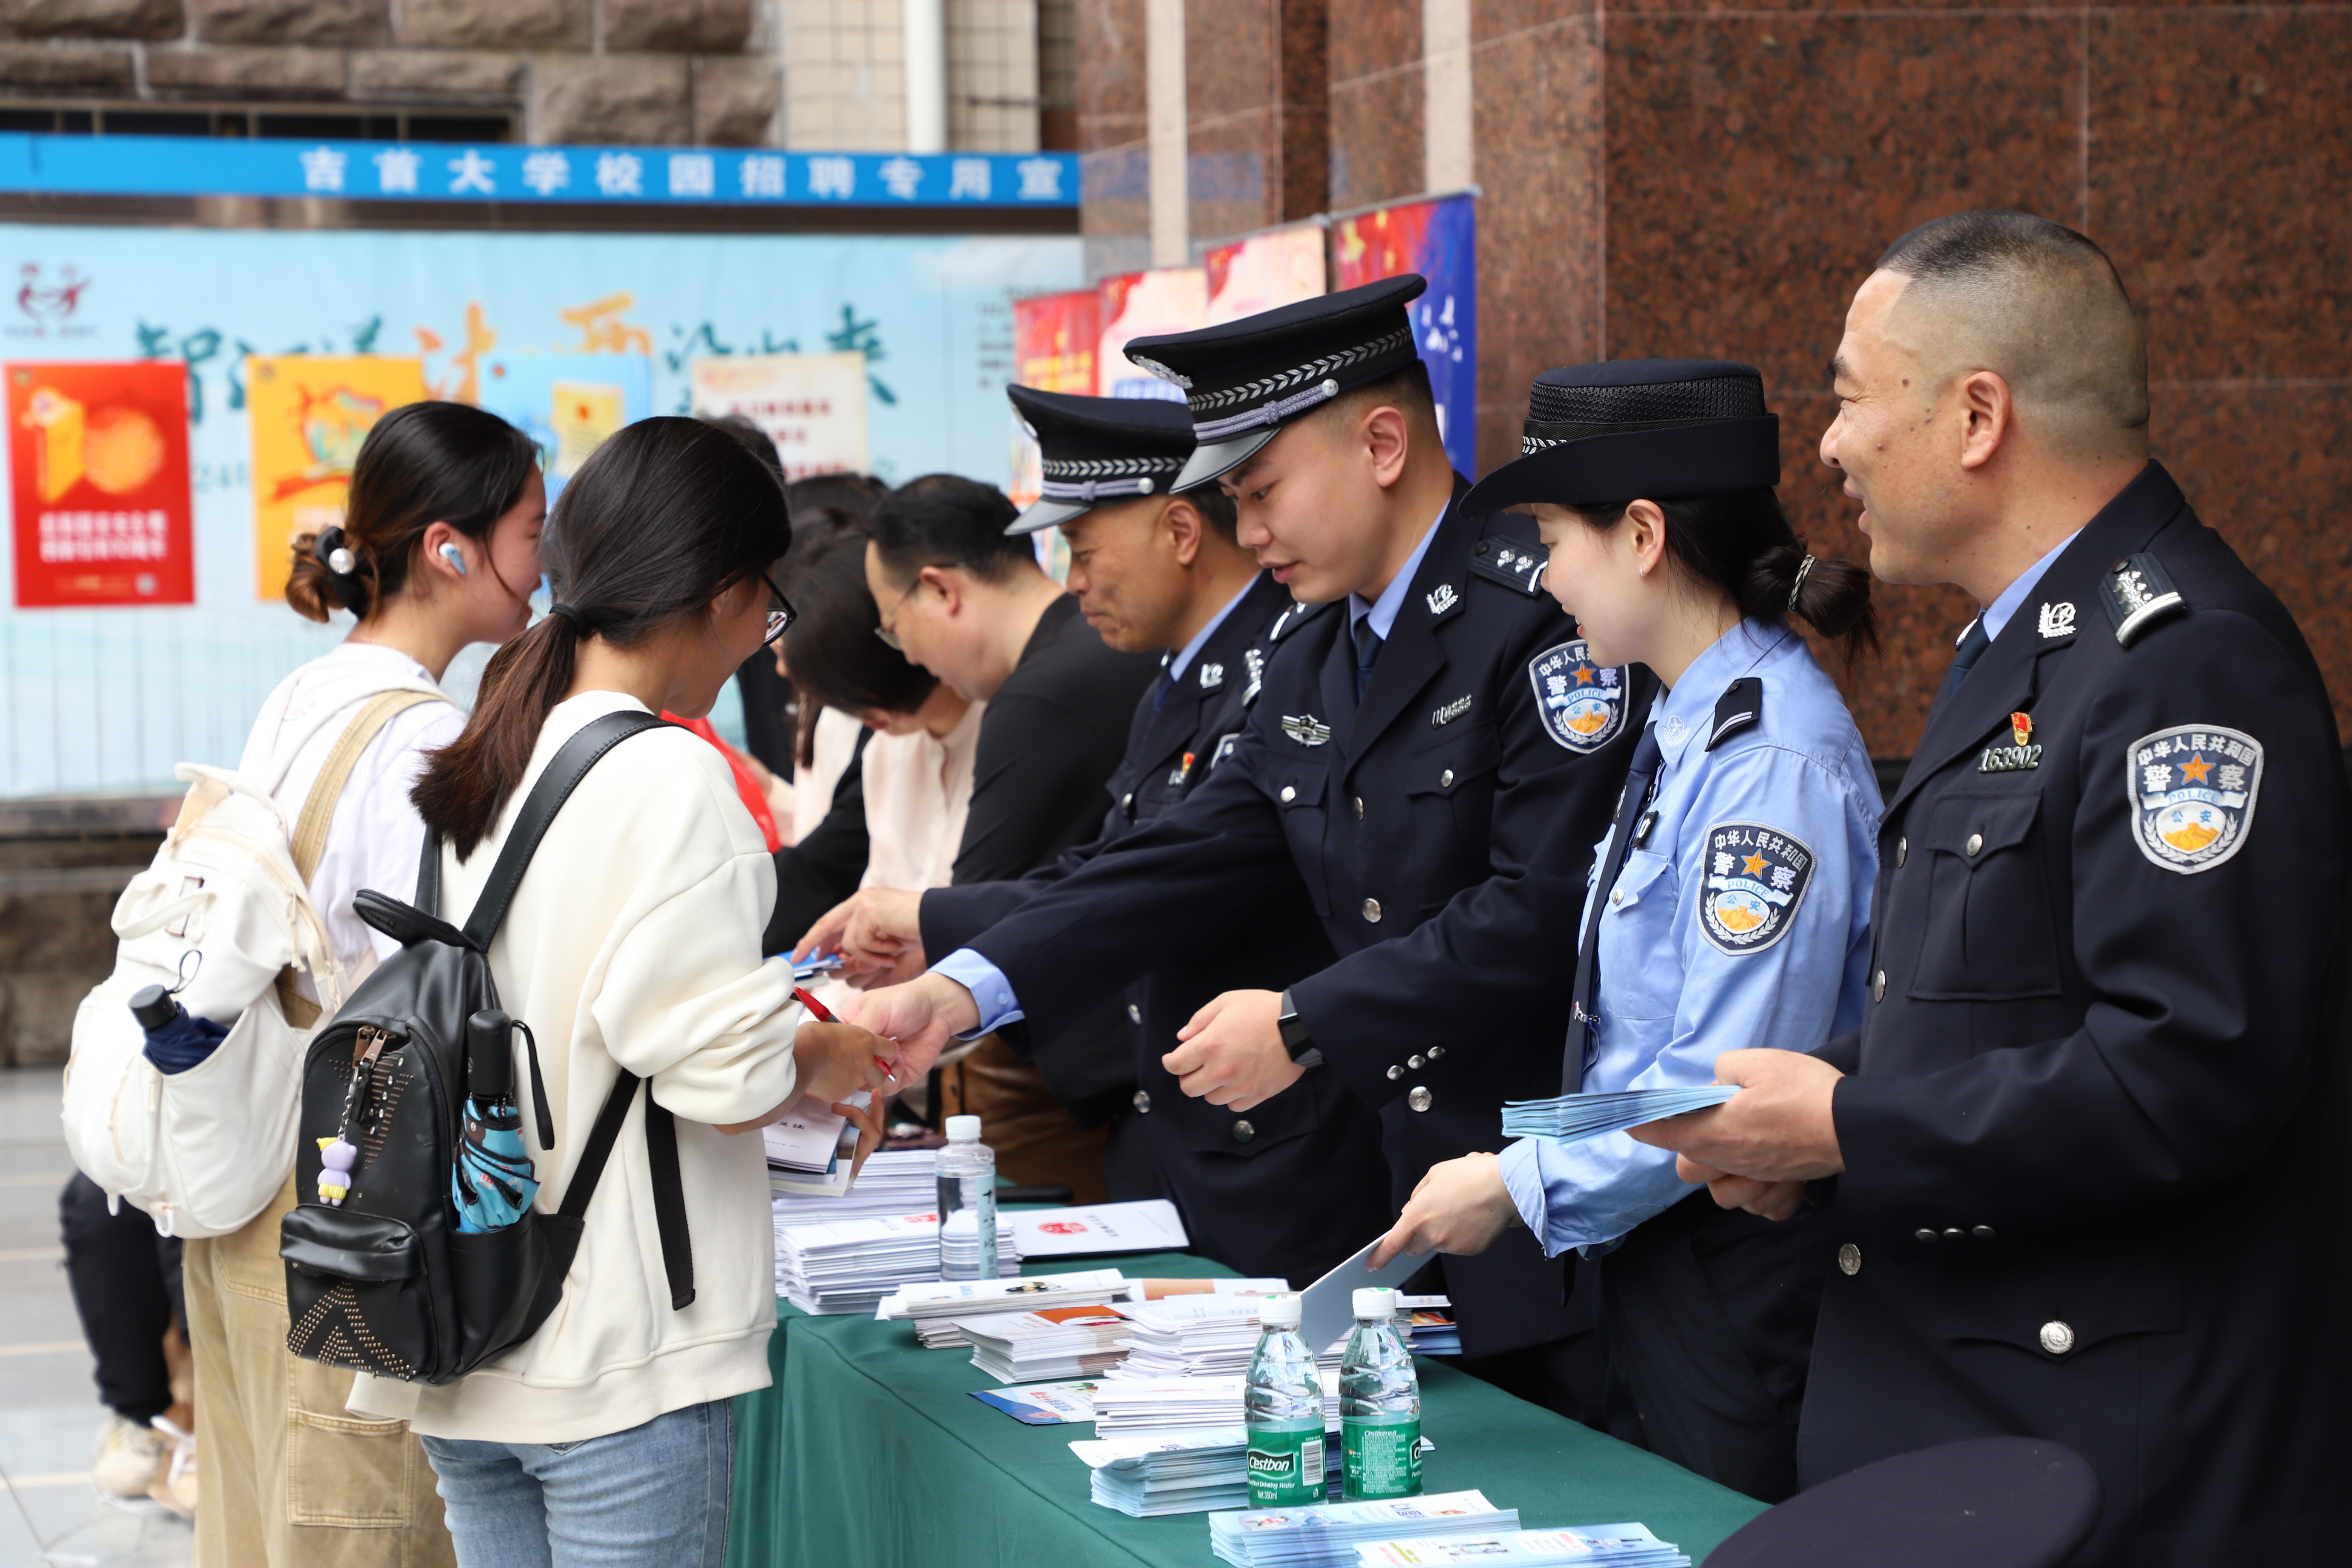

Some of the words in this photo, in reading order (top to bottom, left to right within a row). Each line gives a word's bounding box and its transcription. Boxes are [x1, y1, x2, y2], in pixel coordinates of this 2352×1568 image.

[300, 145, 1064, 200] 吉首大学校园招聘专用宣
[1546, 675, 1568, 696] 警
[1567, 689, 1604, 702] POLICE
[1977, 744, 2042, 773] 163902
[2137, 734, 2257, 767] 中华人民共和国
[2143, 763, 2173, 793] 警
[2218, 763, 2245, 791] 察
[2168, 791, 2220, 804] POLICE
[1715, 830, 1808, 872] 中华人民共和国
[1713, 851, 1736, 876] 警
[1770, 865, 1797, 891] 察
[1727, 880, 1769, 898] POLICE
[1249, 1456, 1290, 1472] C'estbon
[1259, 1481, 1278, 1490] Drinking
